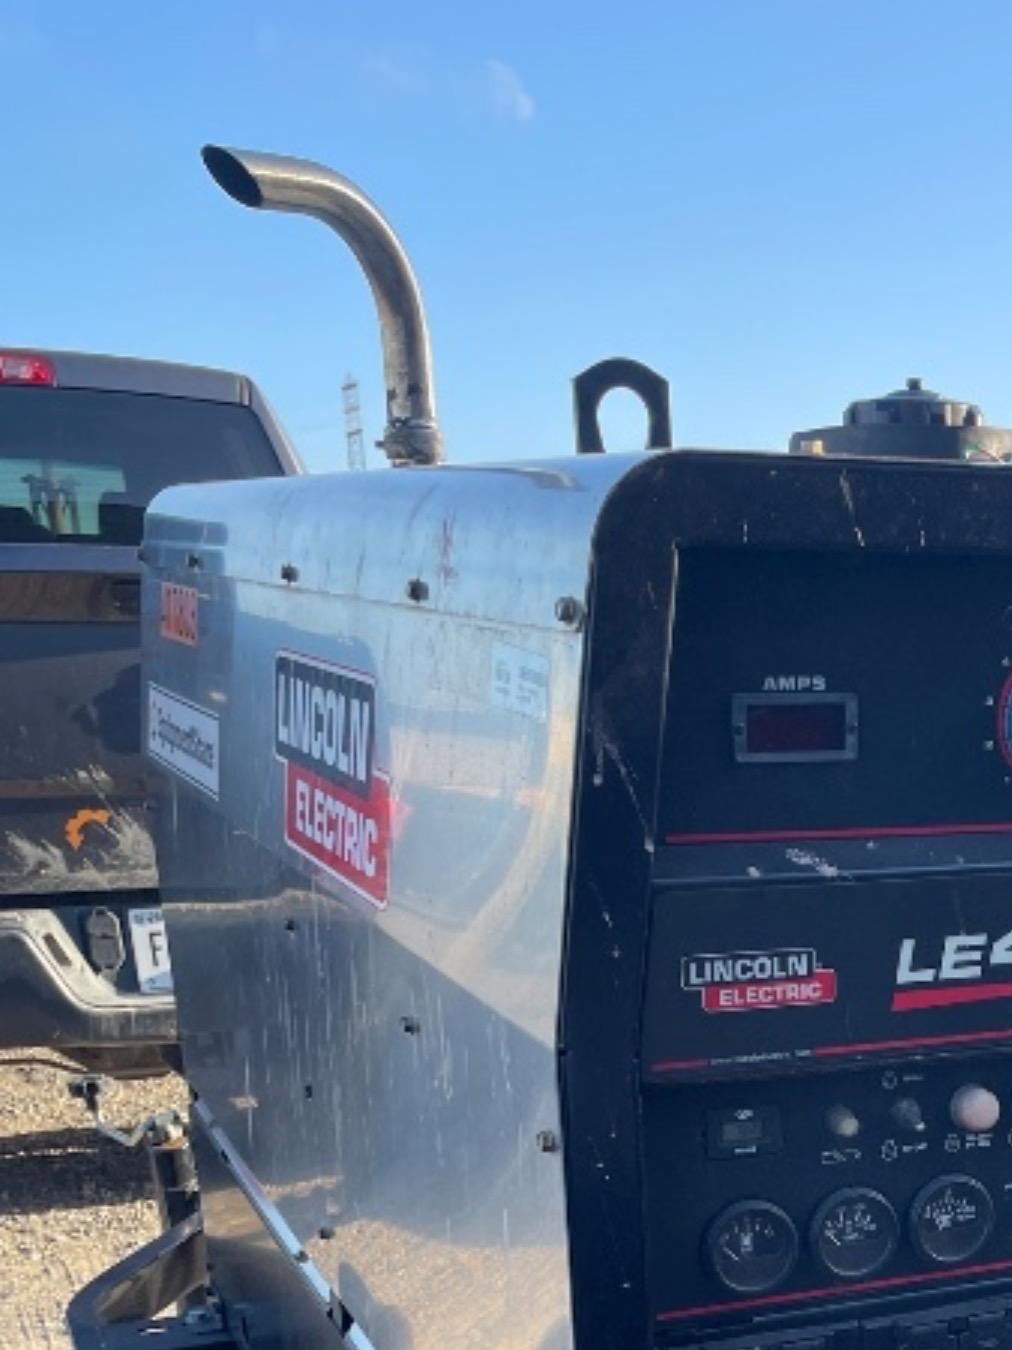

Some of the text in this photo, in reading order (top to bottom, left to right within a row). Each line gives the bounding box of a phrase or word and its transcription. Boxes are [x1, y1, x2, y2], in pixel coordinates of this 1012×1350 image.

[761, 674, 827, 691] AMPS
[277, 671, 370, 784] LINCOLN
[295, 778, 378, 877] ELECTRIC
[688, 952, 809, 985] LINCOLN
[719, 981, 823, 1006] ELECTRIC
